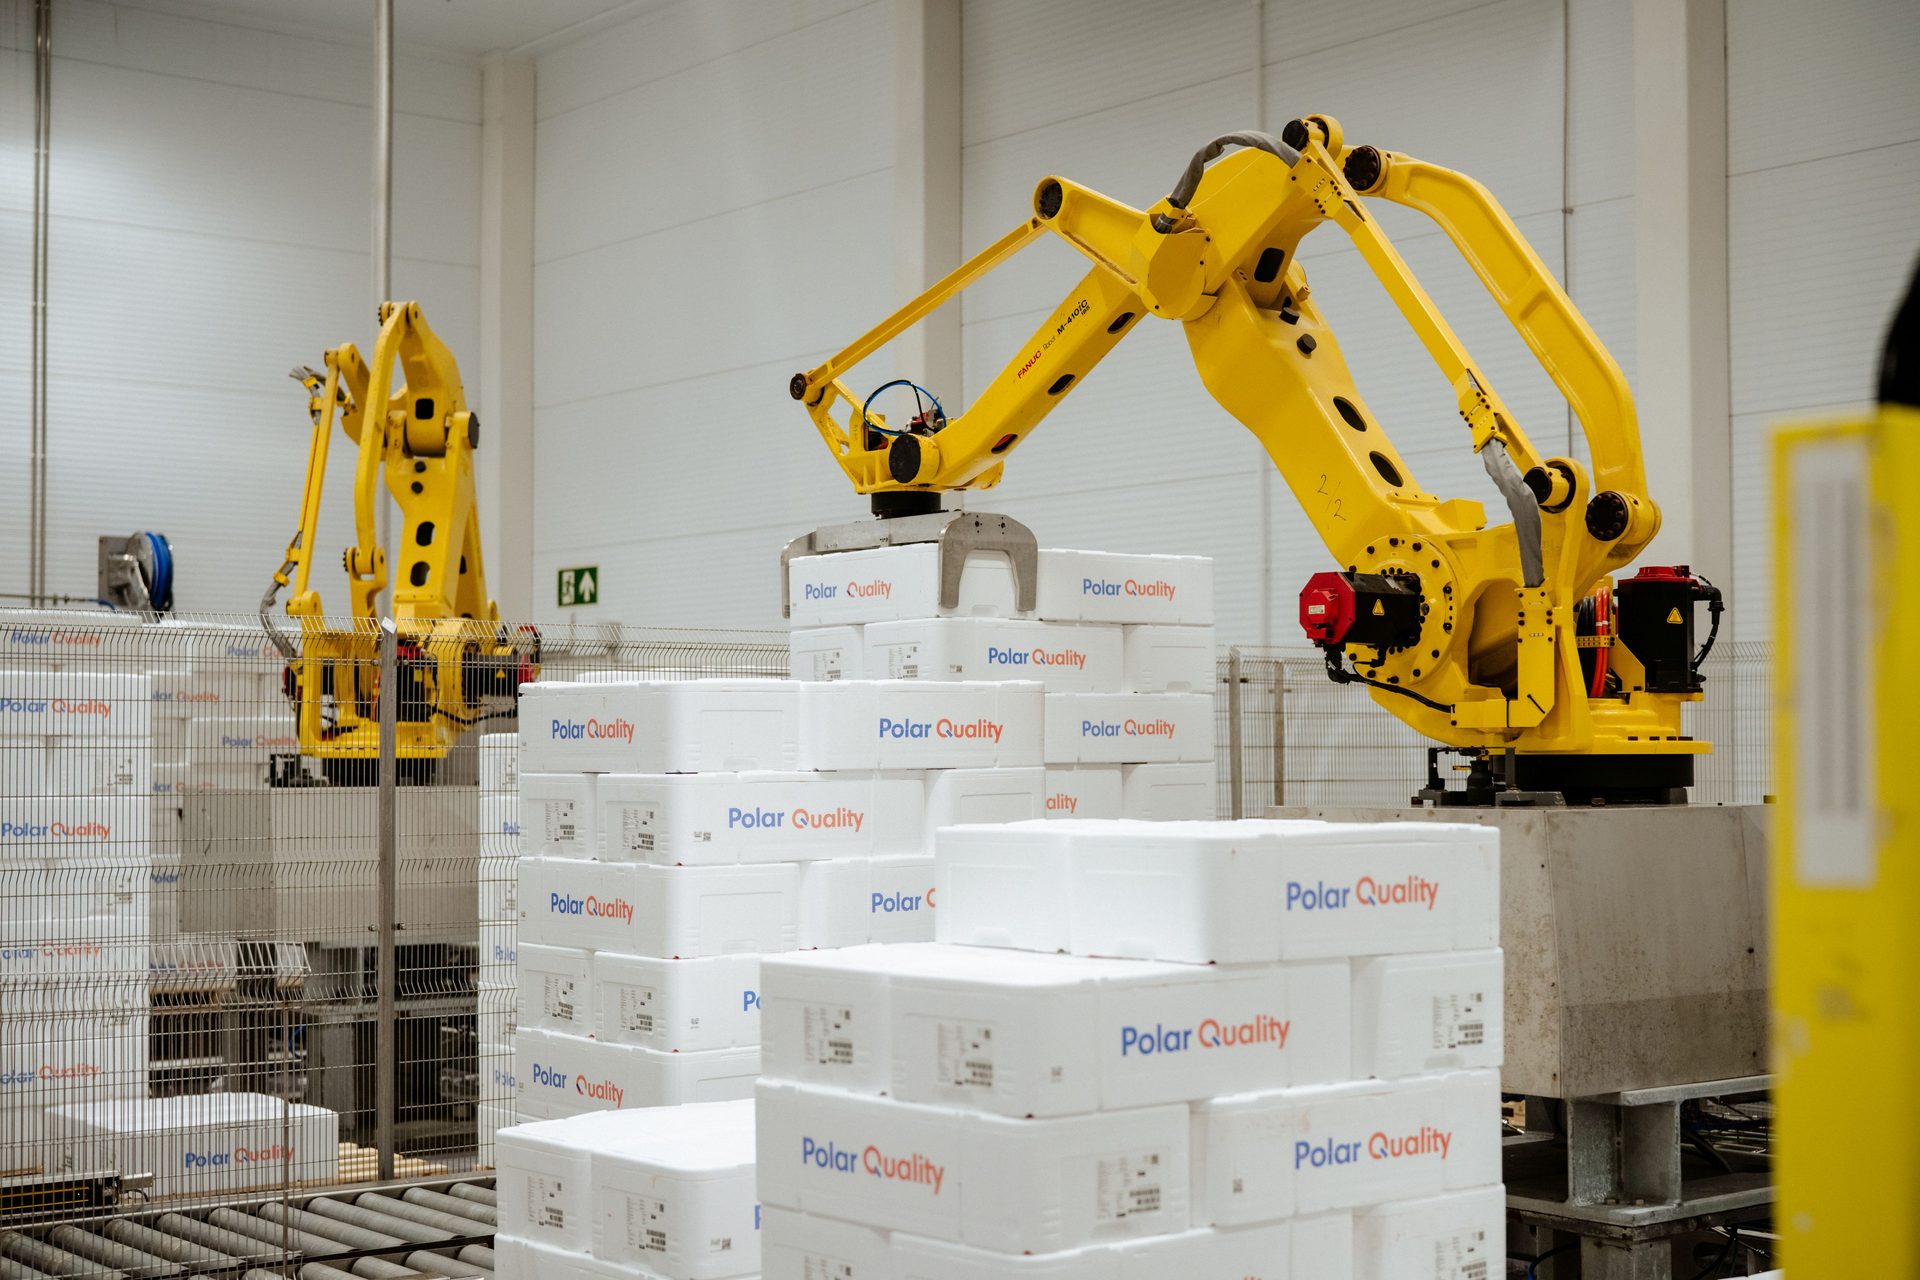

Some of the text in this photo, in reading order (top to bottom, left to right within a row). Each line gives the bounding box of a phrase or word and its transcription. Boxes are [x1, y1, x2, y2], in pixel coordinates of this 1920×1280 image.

[1017, 350, 1042, 379] FANUC
[805, 579, 892, 599] Polar Quality
[1083, 578, 1176, 600] Polar Quality
[11, 630, 102, 647] Polar Quality
[988, 647, 1086, 669] Polar Quality
[0, 697, 112, 718] Polar Quality
[552, 718, 634, 743] Polar Quality
[879, 717, 1003, 743] Polar Quality
[1082, 719, 1175, 739] Polar Quality
[1046, 793, 1077, 814] ality
[1, 822, 111, 840] Polar Quality
[728, 807, 864, 832] Polar Quality
[871, 892, 922, 913] Polar
[1286, 876, 1439, 911] Polar Quality
[550, 892, 634, 925] Polar Quality
[1121, 1015, 1291, 1057] Polar Quality
[39, 1064, 101, 1081] Quality
[533, 1063, 624, 1108] Polar Quality
[185, 1144, 295, 1168] Polar Quality
[1295, 1126, 1452, 1169] Polar Quality
[802, 1137, 945, 1195] Polar Quality
